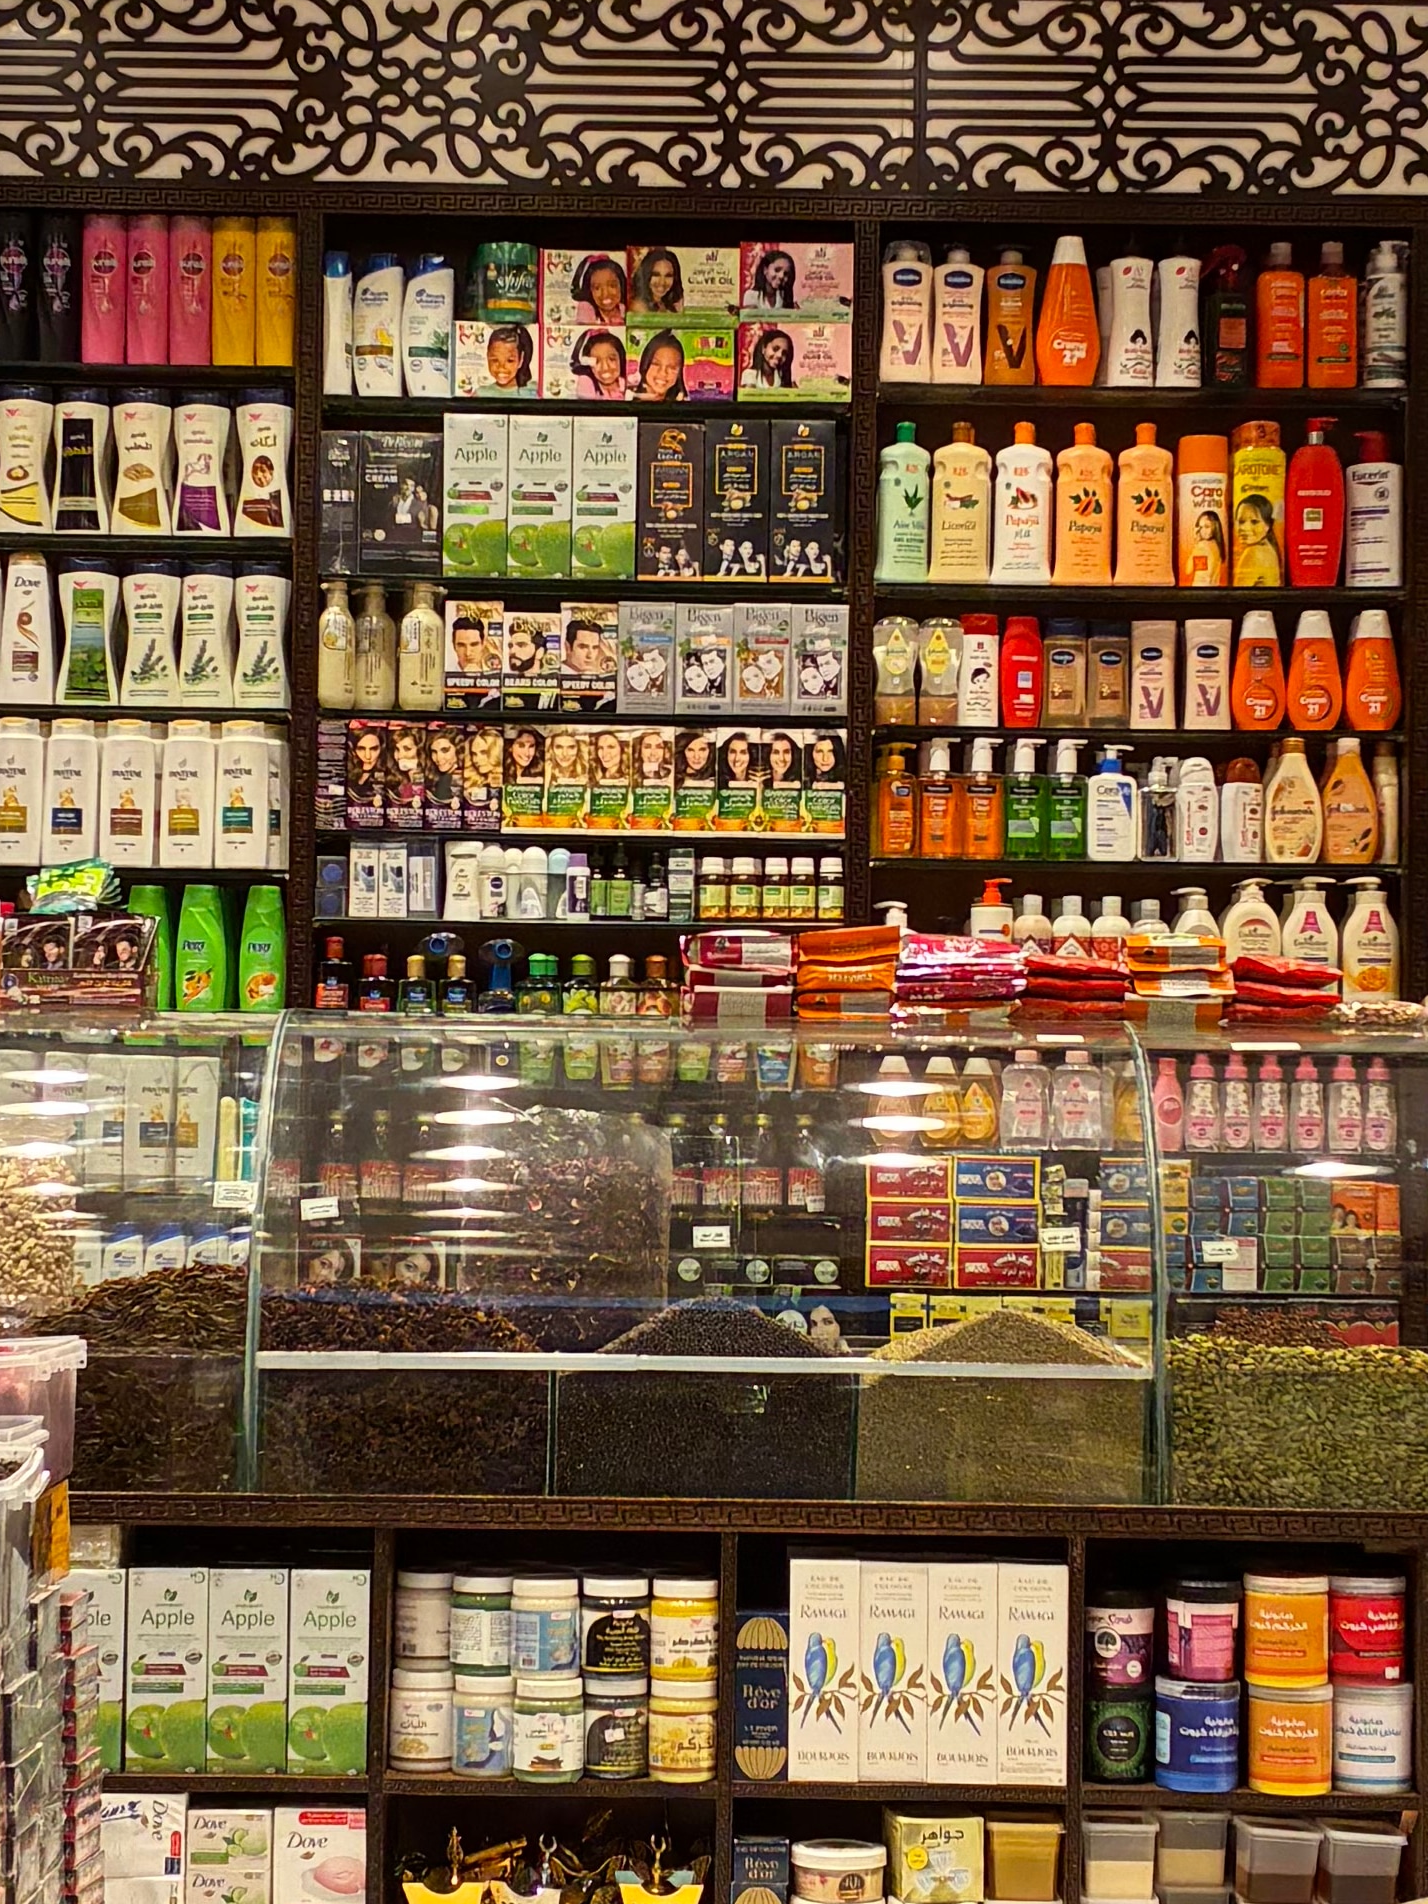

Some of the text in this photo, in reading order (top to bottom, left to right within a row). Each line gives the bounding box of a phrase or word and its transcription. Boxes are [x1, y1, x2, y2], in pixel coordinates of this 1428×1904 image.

[455, 447, 497, 462] Apple
[518, 448, 562, 463] Apple
[583, 449, 626, 464] Apple
[1352, 470, 1390, 480] Eucerin
[14, 576, 41, 589] Dove
[141, 1609, 194, 1629] Apple
[221, 1610, 275, 1629] Apple
[303, 1610, 356, 1630] Apple
[152, 1800, 169, 1841] Dove
[194, 1815, 227, 1830] Dove
[287, 1832, 328, 1849] Dove
[921, 1826, 964, 1846] جواهر
[192, 1873, 225, 1888] Dove
